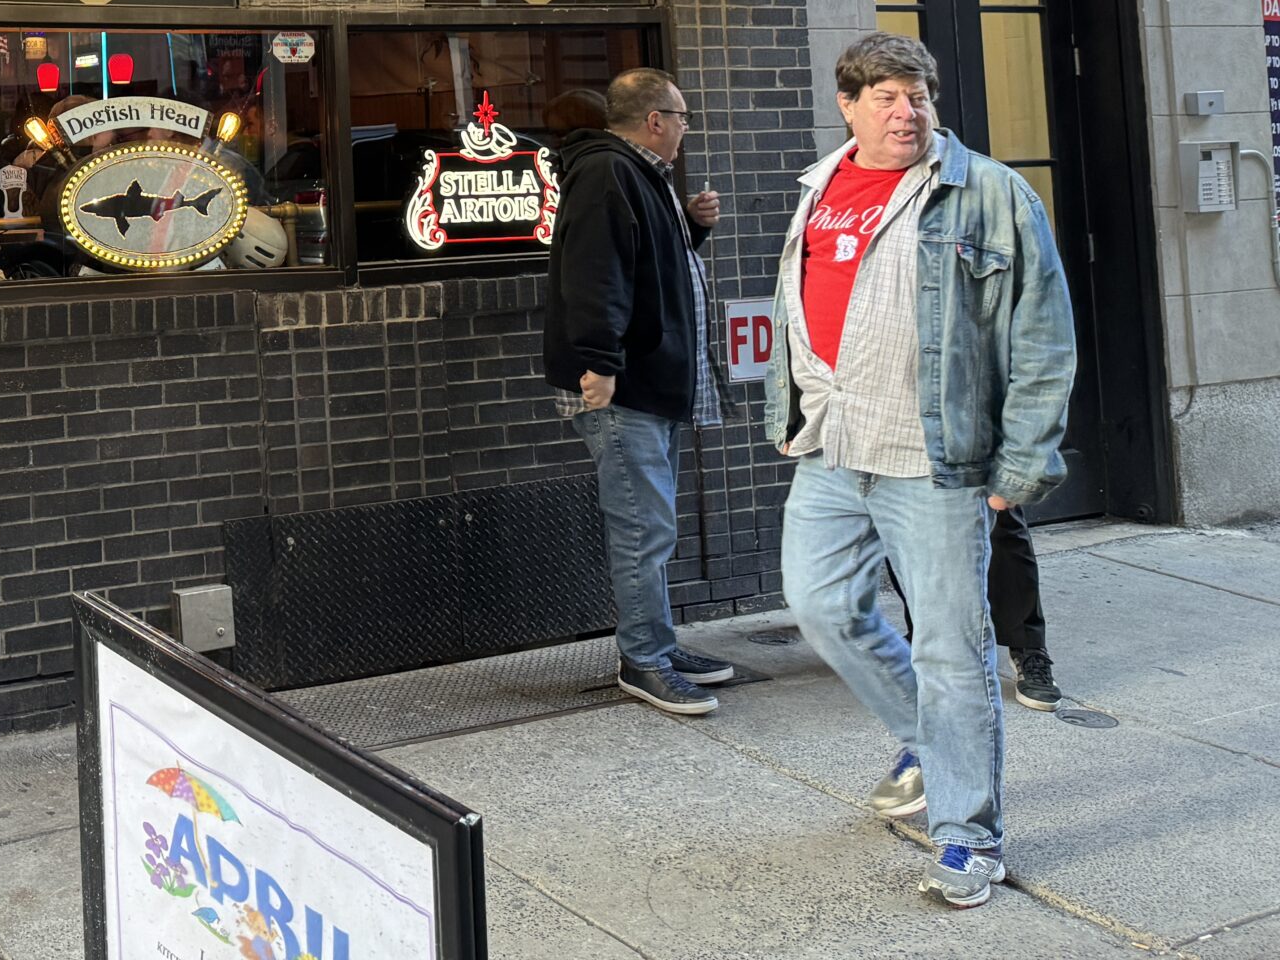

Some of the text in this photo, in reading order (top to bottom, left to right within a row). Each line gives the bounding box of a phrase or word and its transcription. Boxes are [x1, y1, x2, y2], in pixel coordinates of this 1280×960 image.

[66, 103, 200, 136] Dogfish Head
[439, 169, 541, 197] STELLA
[438, 195, 541, 224] ARTOIS
